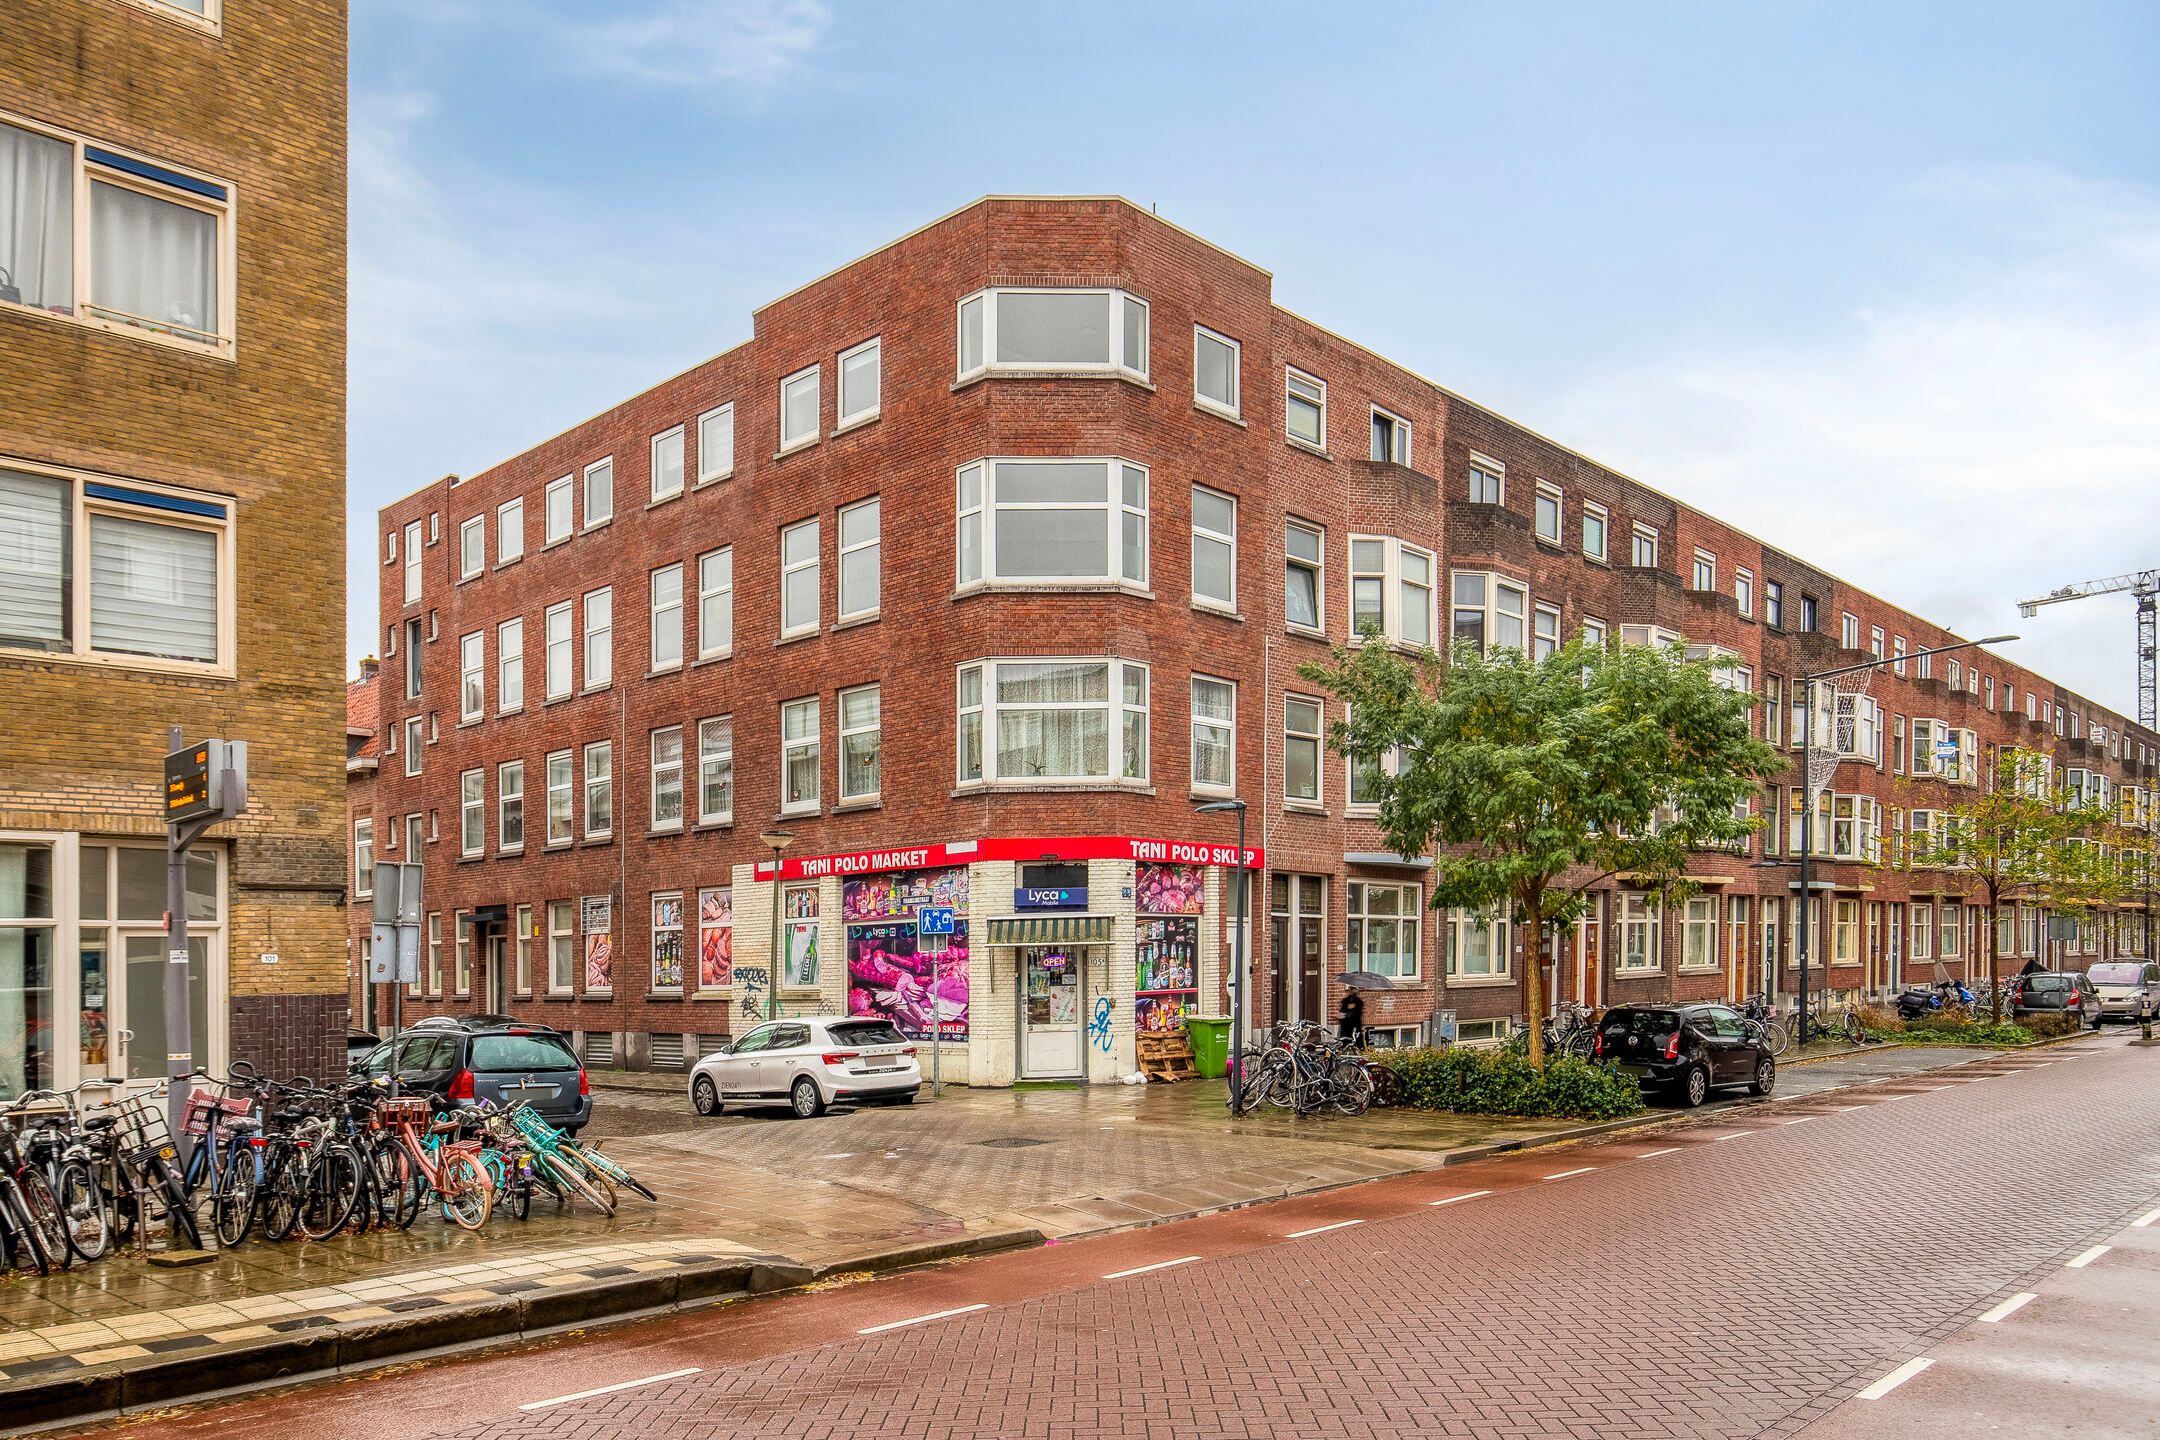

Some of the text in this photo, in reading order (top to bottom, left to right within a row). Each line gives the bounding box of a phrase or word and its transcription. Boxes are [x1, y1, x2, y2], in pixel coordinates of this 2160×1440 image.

[1130, 841, 1166, 859] TANI
[1172, 845, 1209, 862] POLO
[801, 850, 928, 876] TANI POLO MARKET
[1028, 889, 1059, 902] Lyca
[1043, 958, 1065, 967] OPEN
[922, 1025, 966, 1034] POO SKLEP
